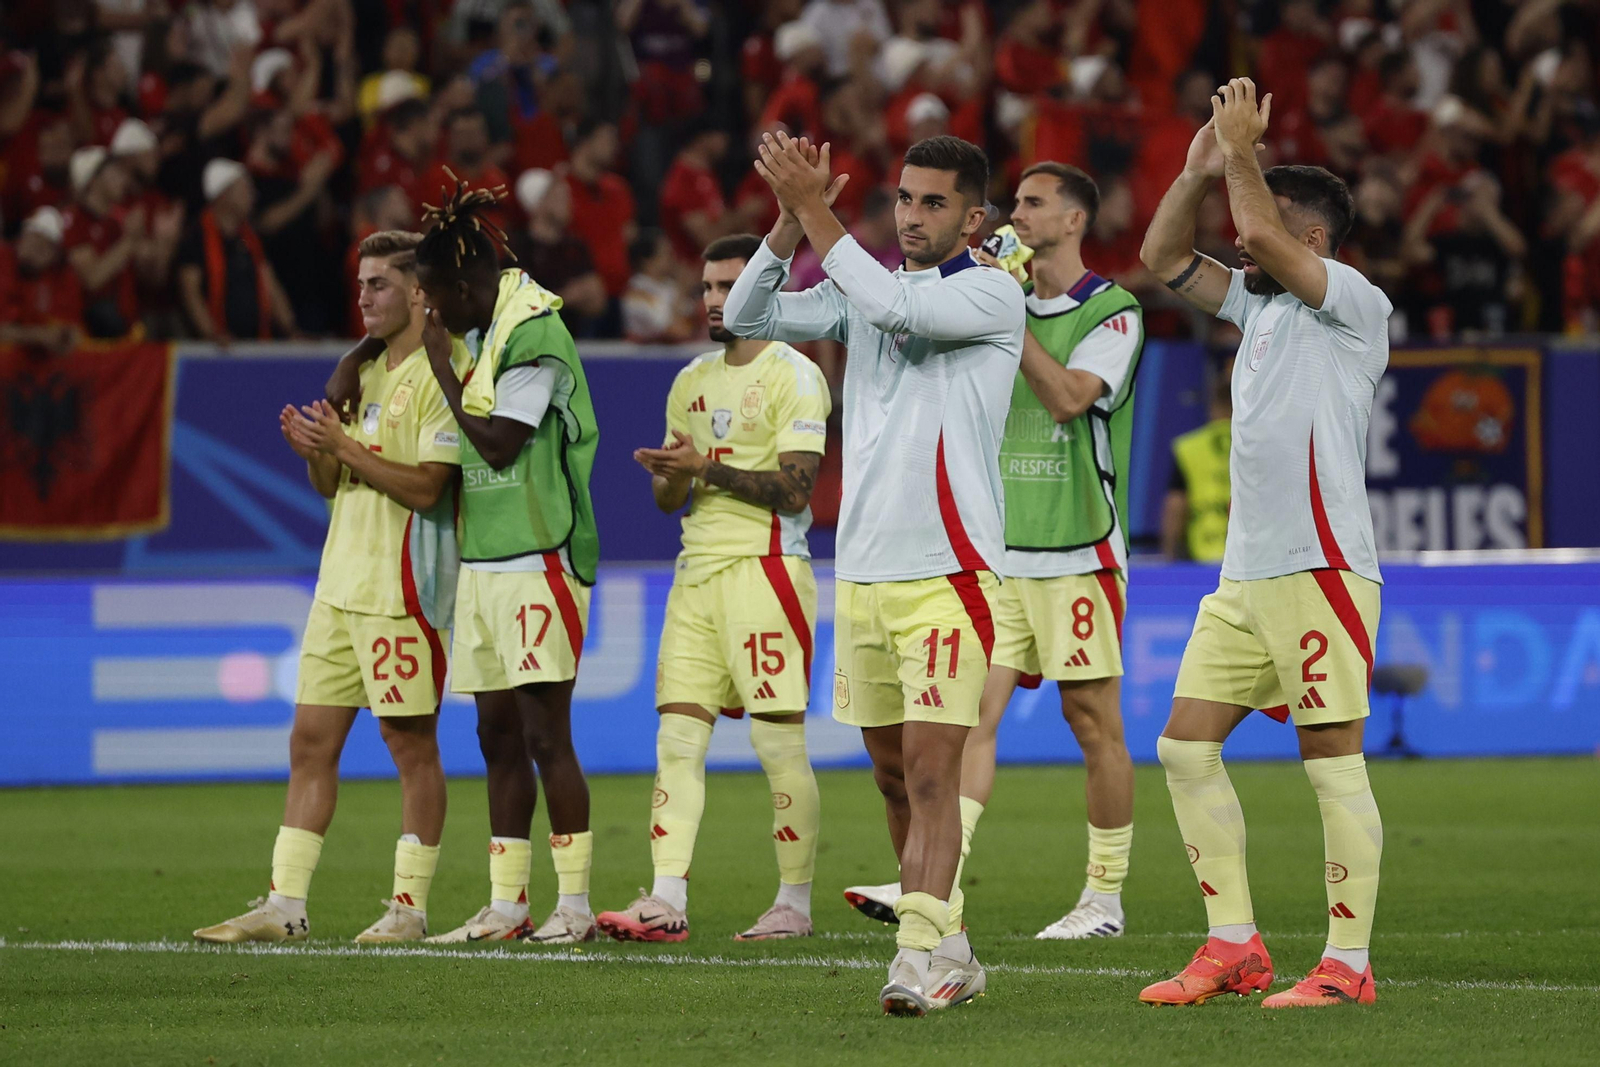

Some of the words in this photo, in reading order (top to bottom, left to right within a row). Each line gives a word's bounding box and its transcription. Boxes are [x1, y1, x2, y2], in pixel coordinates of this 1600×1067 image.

[1009, 459, 1068, 476] RESPEC
[515, 604, 552, 648] 17
[1071, 596, 1095, 641] 8
[371, 635, 420, 681] 25
[743, 632, 786, 678] 15
[922, 628, 961, 679] 11
[1299, 630, 1329, 683] 2
